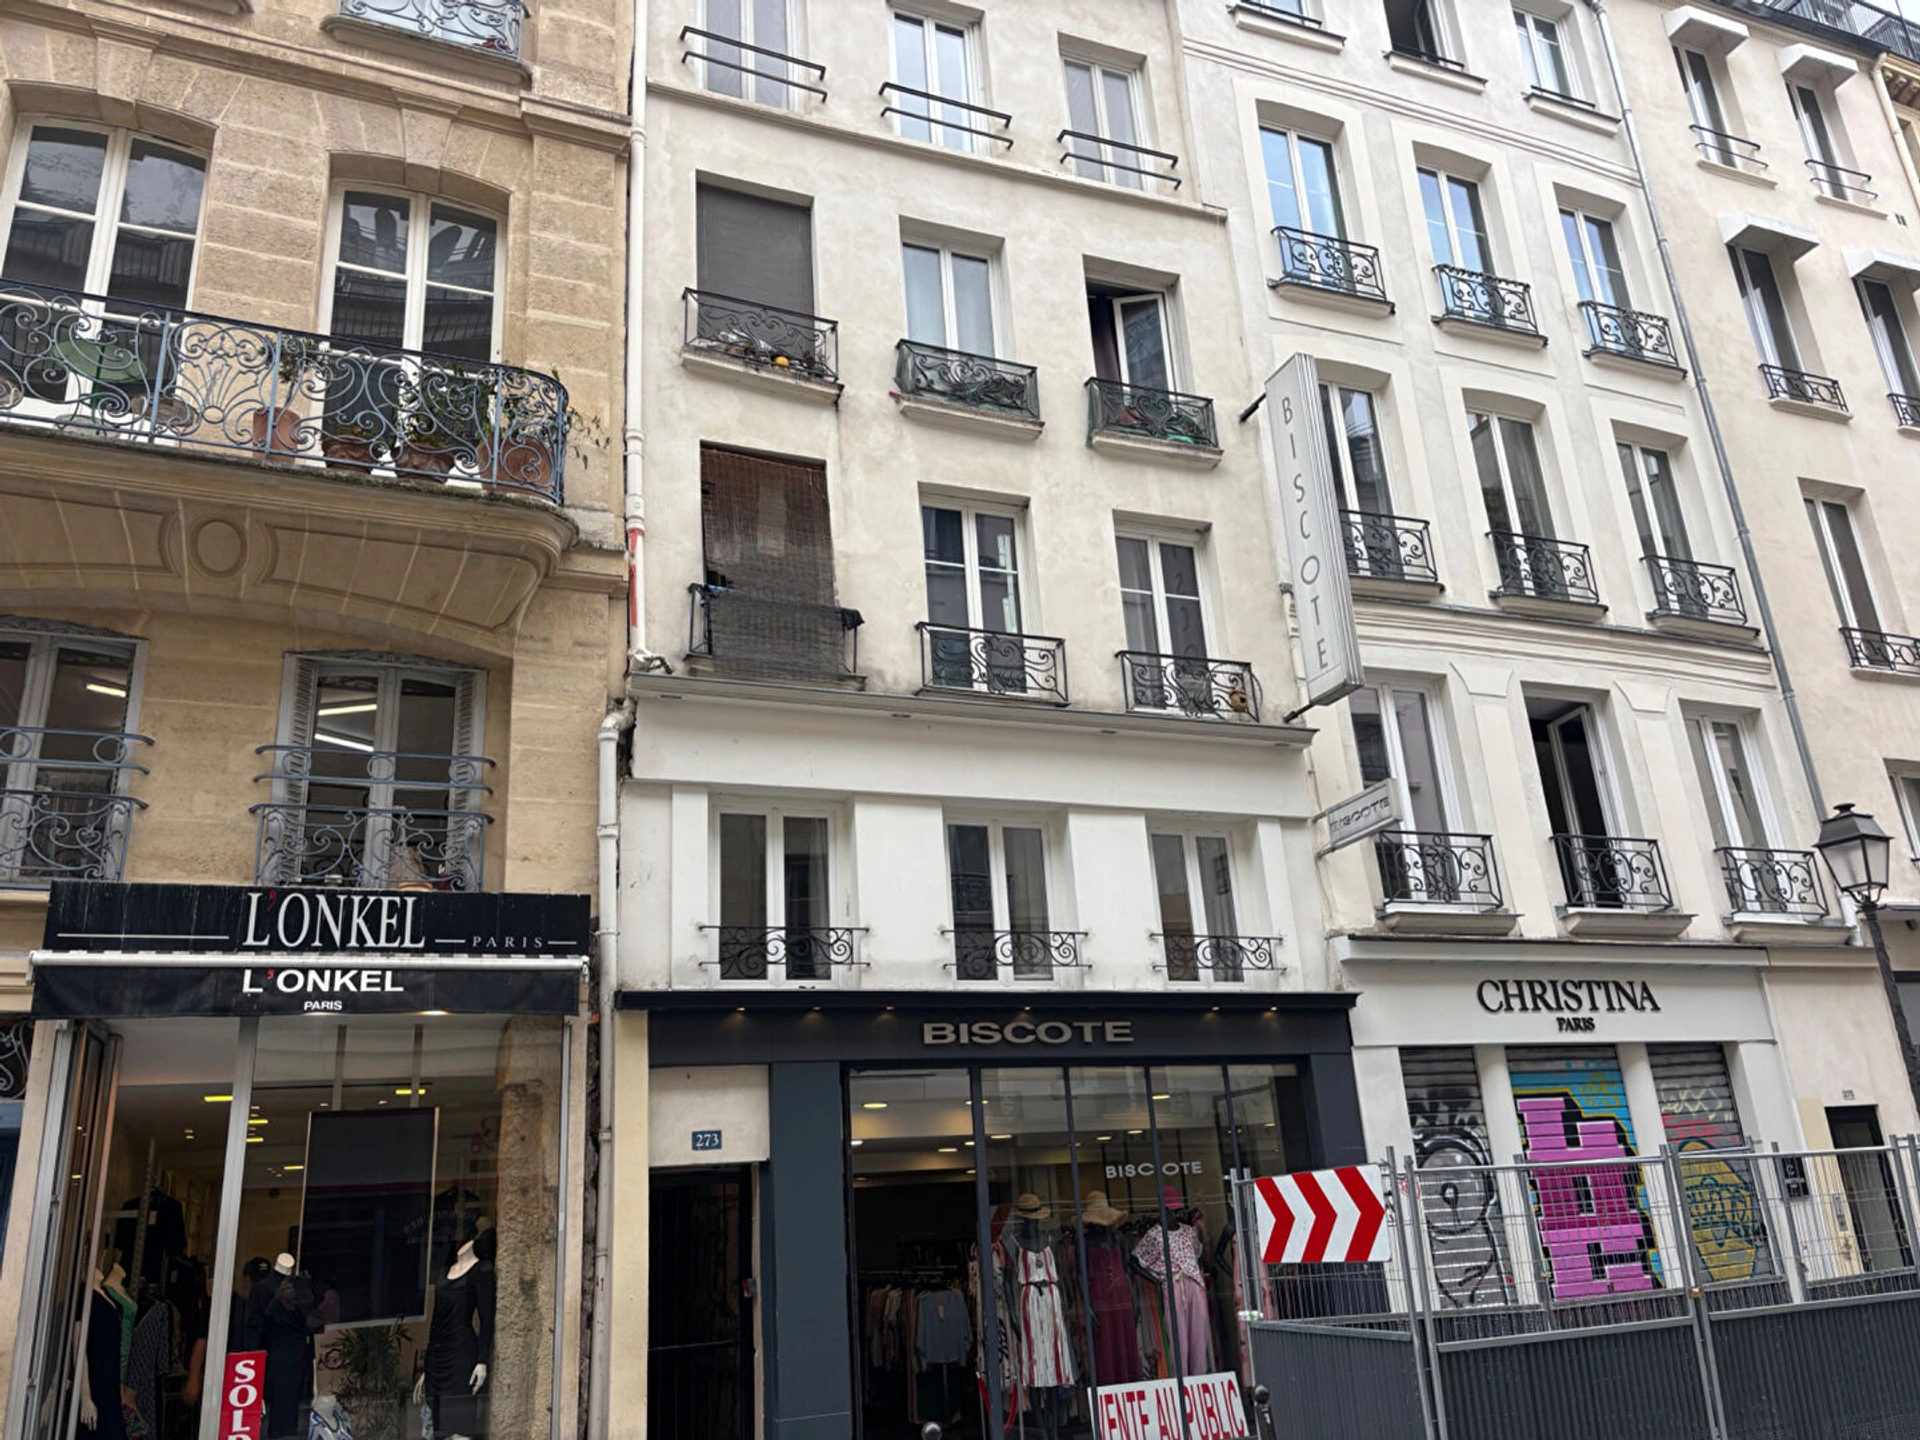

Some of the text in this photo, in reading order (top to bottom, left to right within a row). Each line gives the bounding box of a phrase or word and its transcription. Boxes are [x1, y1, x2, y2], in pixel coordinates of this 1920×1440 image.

[1282, 397, 1327, 670] BISCOTE
[242, 890, 425, 948] L'ONKEL
[472, 935, 544, 949] PARIS
[242, 968, 404, 994] L'ONKEL
[303, 1000, 343, 1012] PARIS
[1477, 979, 1661, 1013] CHRISTINA
[923, 1021, 1135, 1044] BISCOTE
[1556, 1017, 1596, 1032] PARIS
[695, 1133, 719, 1147] 273
[227, 1359, 258, 1440] SOL
[1156, 1386, 1182, 1440] AU
[1183, 1379, 1244, 1440] PUBLIC
